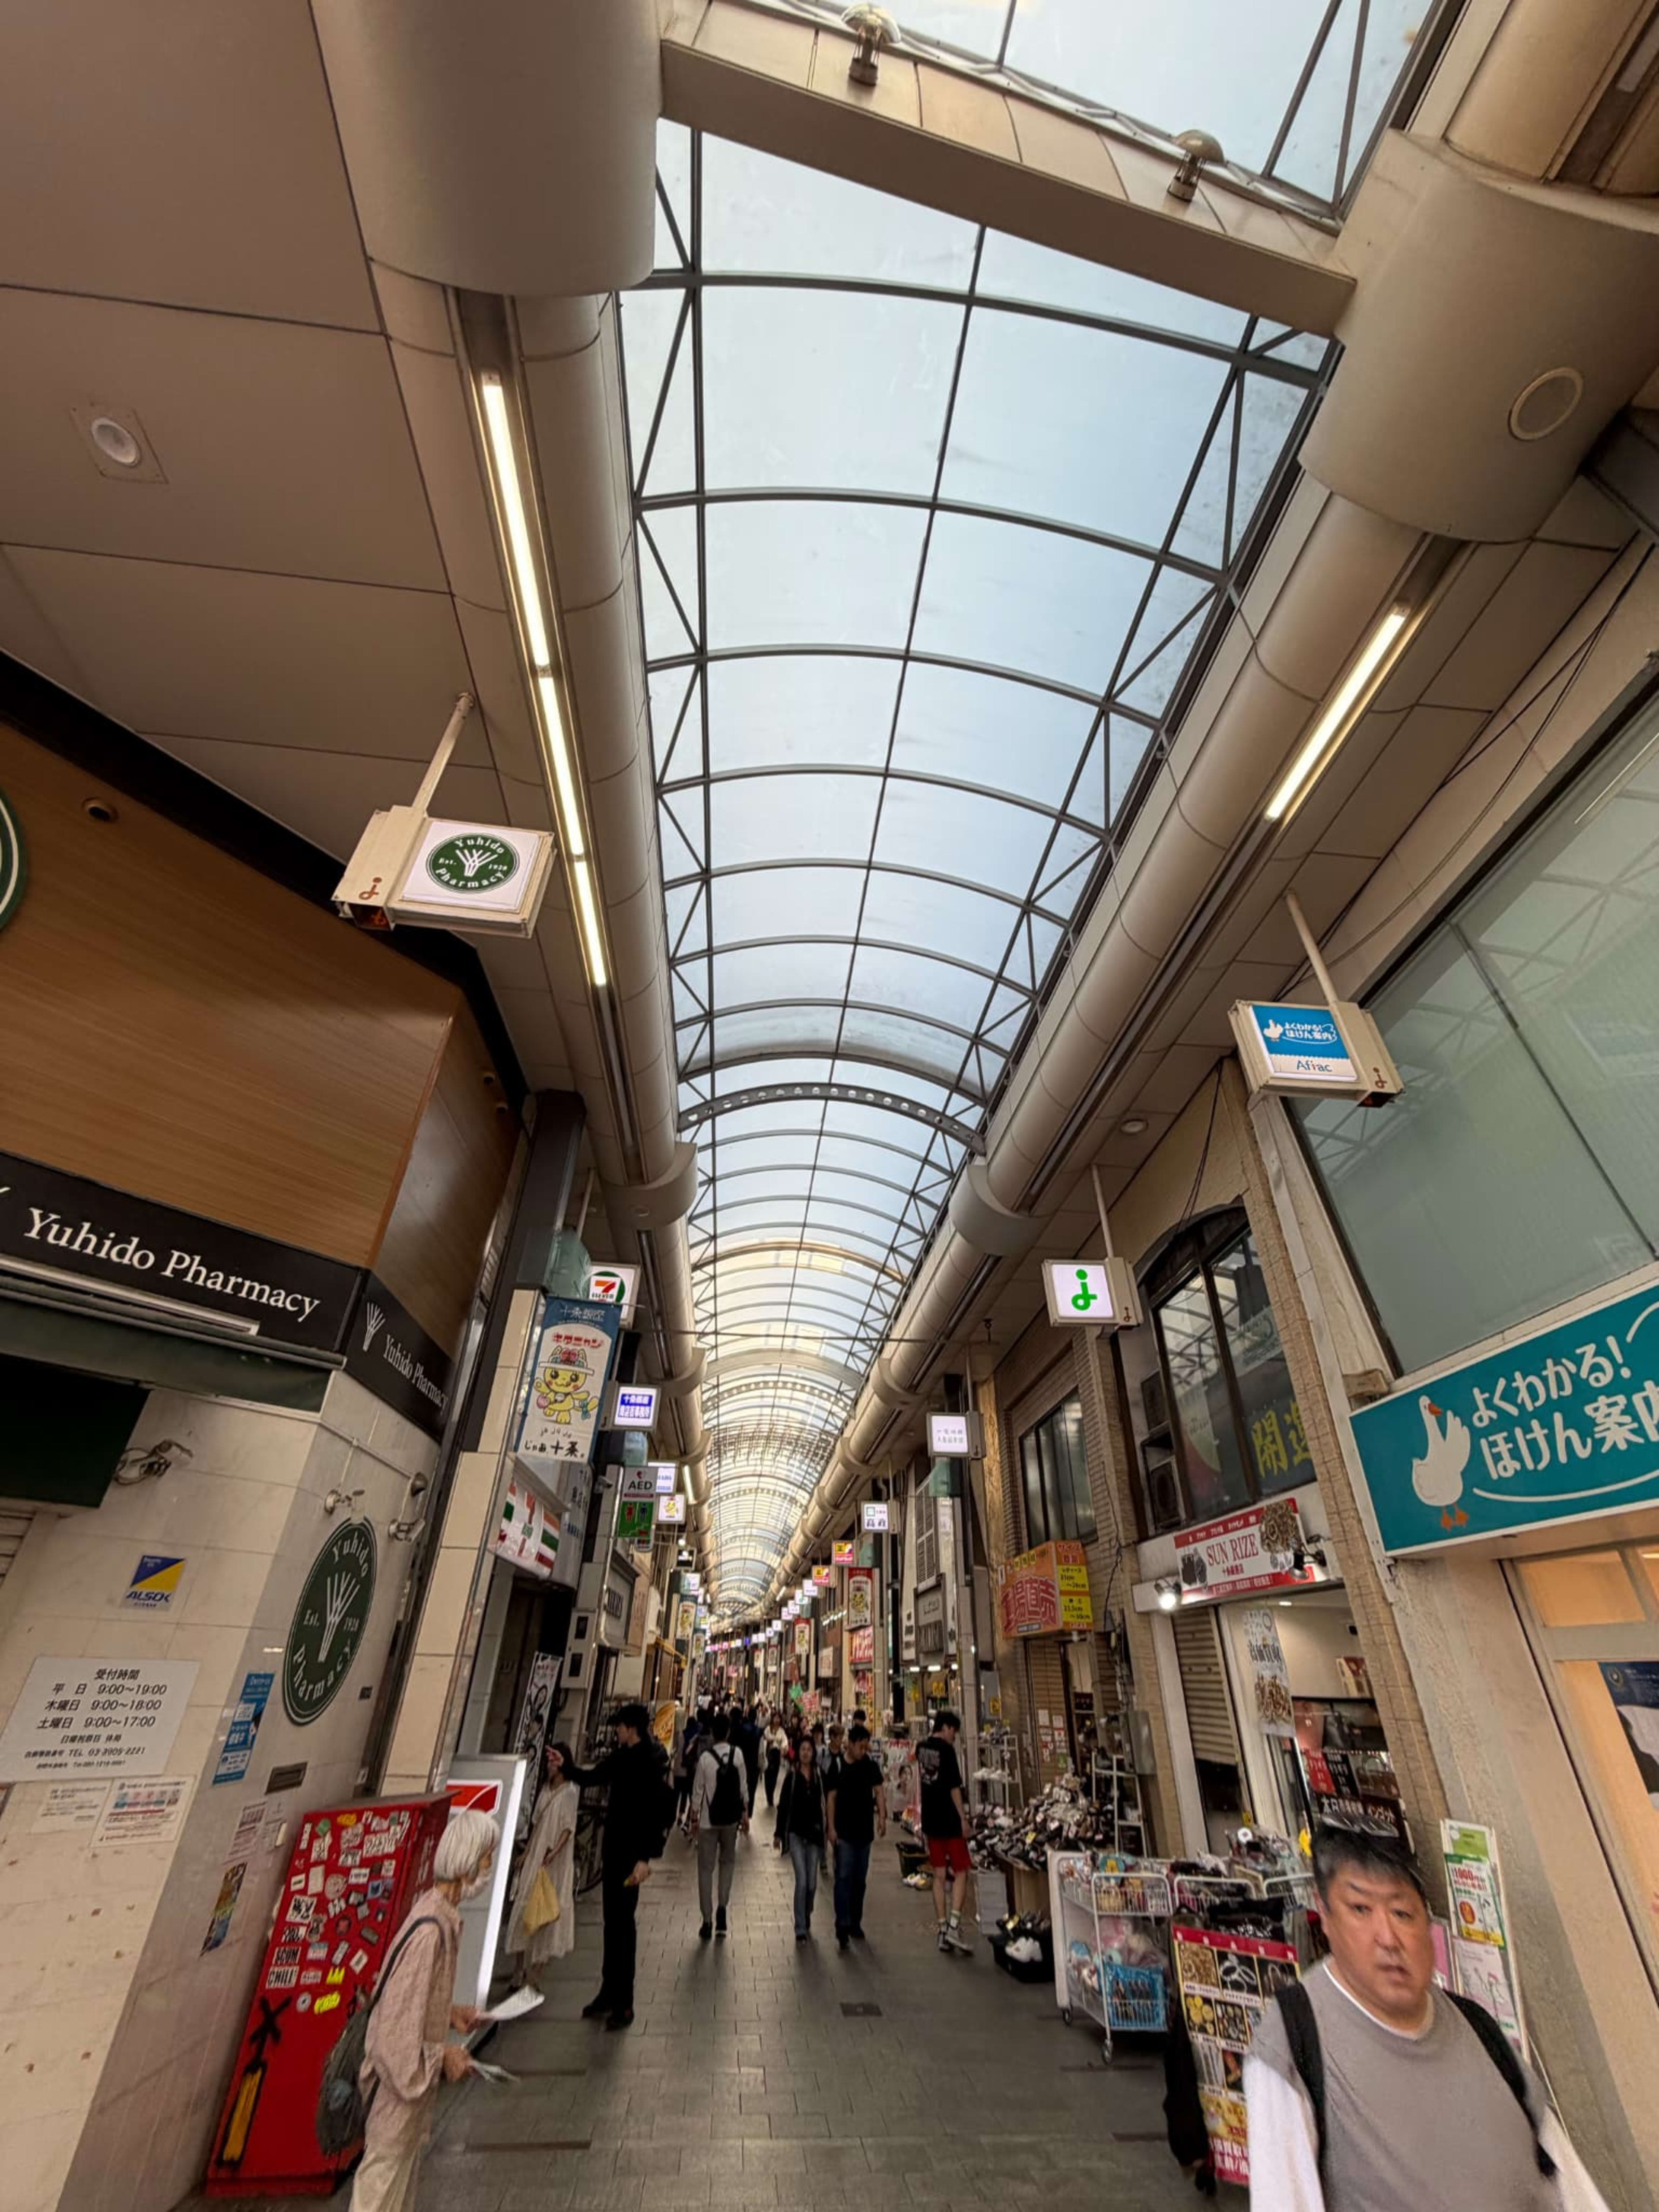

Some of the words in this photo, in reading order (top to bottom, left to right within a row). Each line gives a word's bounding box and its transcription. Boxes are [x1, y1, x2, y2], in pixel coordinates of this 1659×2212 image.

[454, 837, 505, 854] Yuhido
[435, 868, 505, 888] Pharmacy
[1296, 1060, 1332, 1073] Aflac
[24, 1207, 156, 1270] Yuhido
[161, 1249, 321, 1322] Pharmacy
[383, 1334, 413, 1379] Yuhido
[412, 1363, 450, 1414] Pharmacy
[1472, 1335, 1631, 1427] よくわかる!
[628, 1480, 652, 1490] AED
[332, 1531, 369, 1578] Yuhido
[1206, 1541, 1229, 1566] SUN
[1230, 1533, 1259, 1562] RIZE
[125, 1591, 172, 1603] ALSOK
[94, 1669, 140, 1680] 受付時間
[293, 1638, 352, 1701] Pharmacy
[37, 1716, 74, 1729] 土曜日
